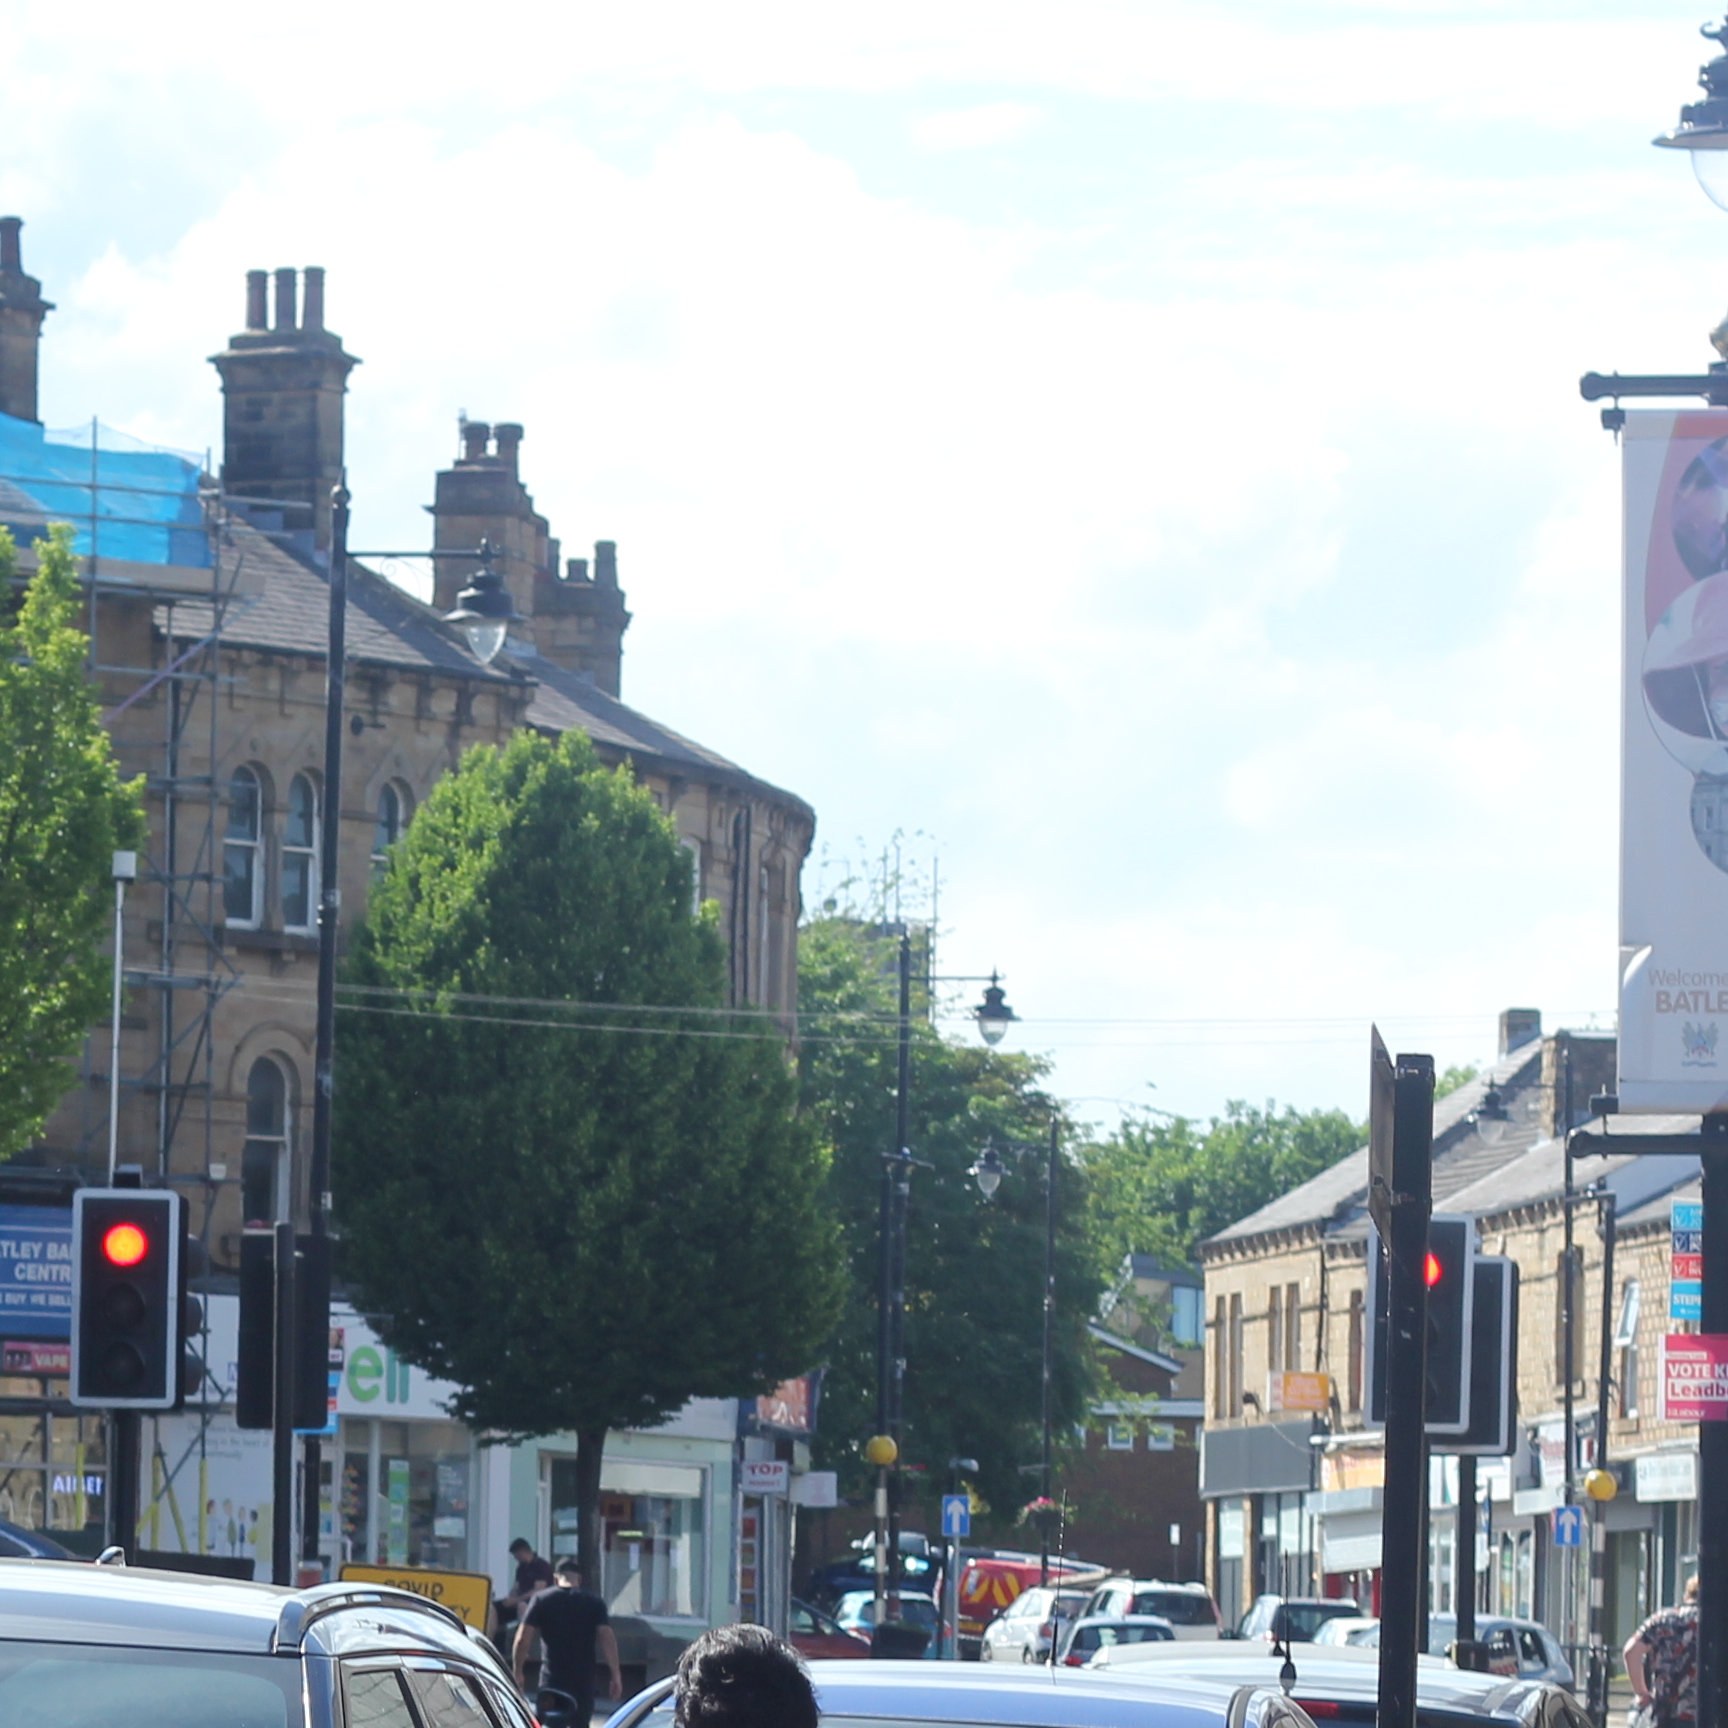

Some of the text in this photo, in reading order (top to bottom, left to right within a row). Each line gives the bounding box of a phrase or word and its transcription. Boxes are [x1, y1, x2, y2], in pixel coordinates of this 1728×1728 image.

[14, 1263, 71, 1281] CENTR
[347, 1346, 410, 1403] ell
[1668, 1363, 1710, 1378] VOTE
[748, 1463, 783, 1476] TOP
